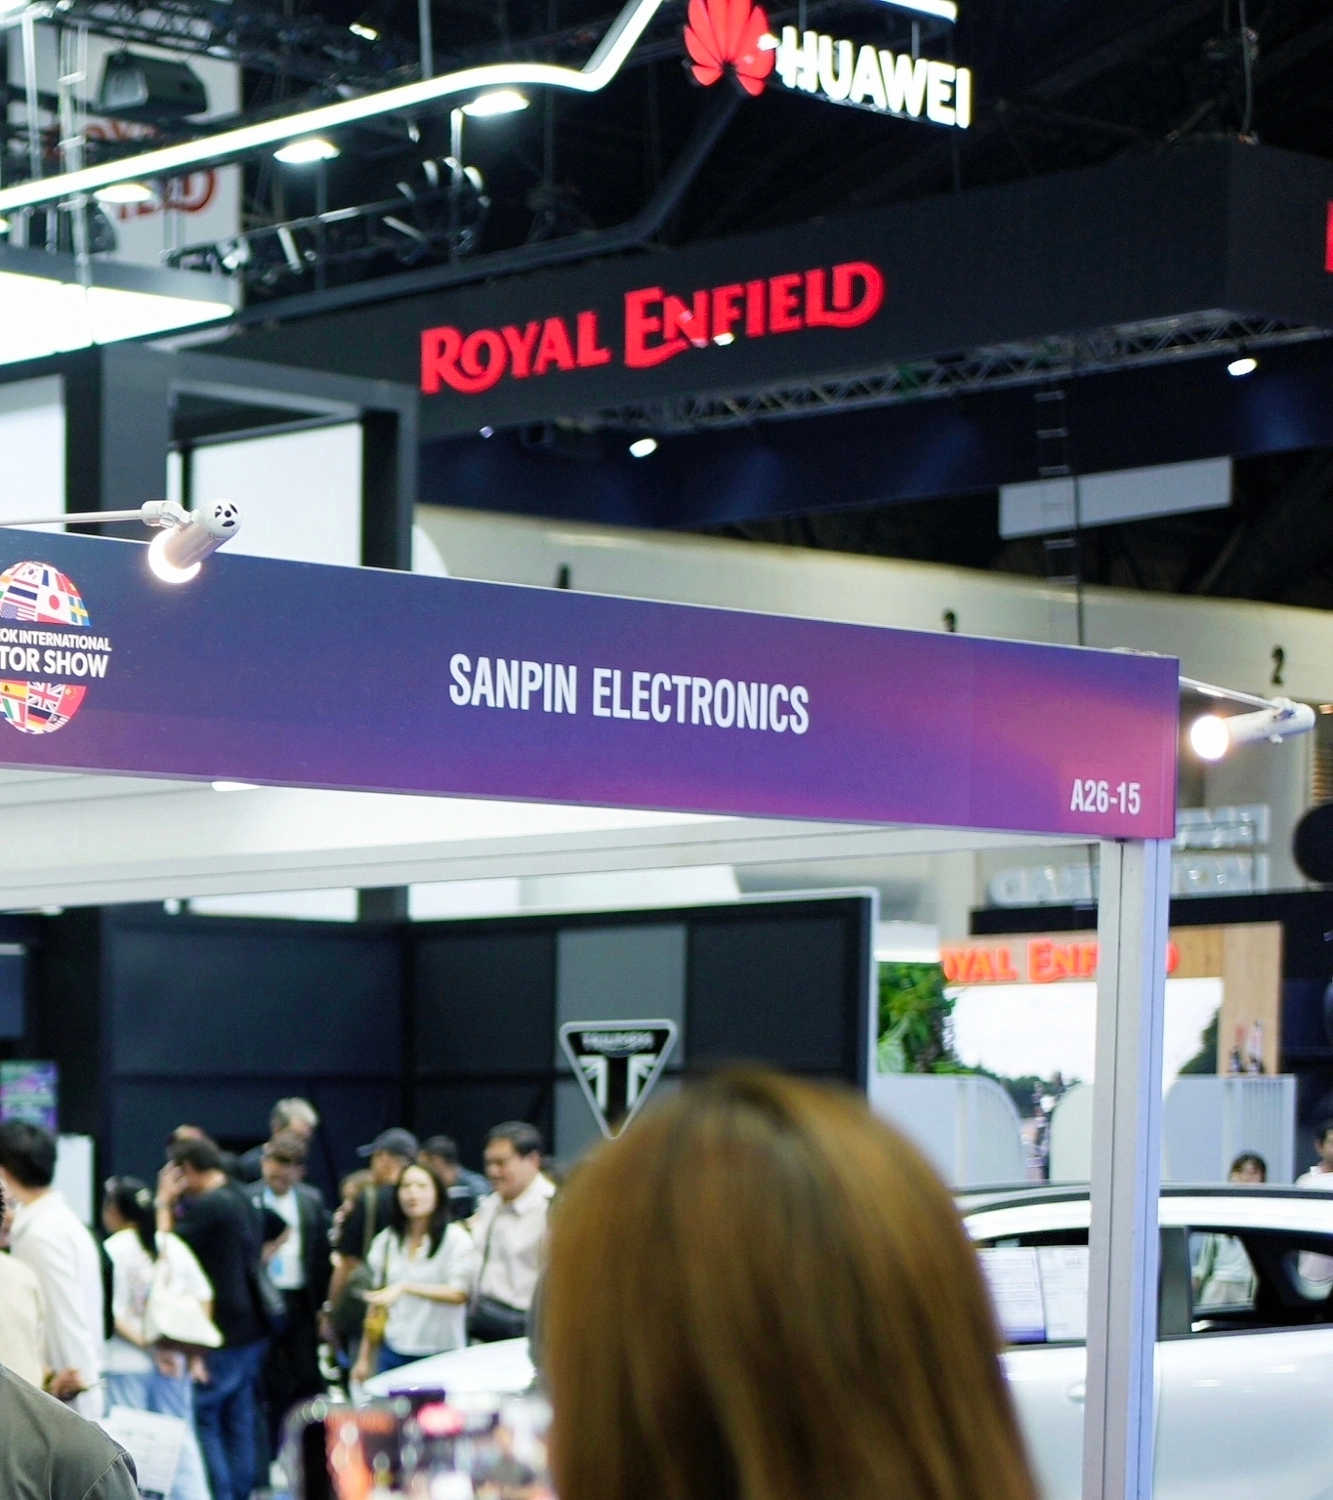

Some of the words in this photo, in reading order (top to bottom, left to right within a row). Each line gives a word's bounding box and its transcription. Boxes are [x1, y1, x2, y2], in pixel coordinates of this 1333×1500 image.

[780, 25, 971, 129] HUAWEI
[421, 311, 611, 394] ROYAL
[624, 261, 884, 368] ENFIELD
[19, 629, 112, 652] INTERNATIONAL
[43, 649, 109, 679] SHOW
[448, 653, 577, 715] SANPIN
[592, 665, 809, 735] ELECTRONICS
[1070, 779, 1141, 816] A26-15
